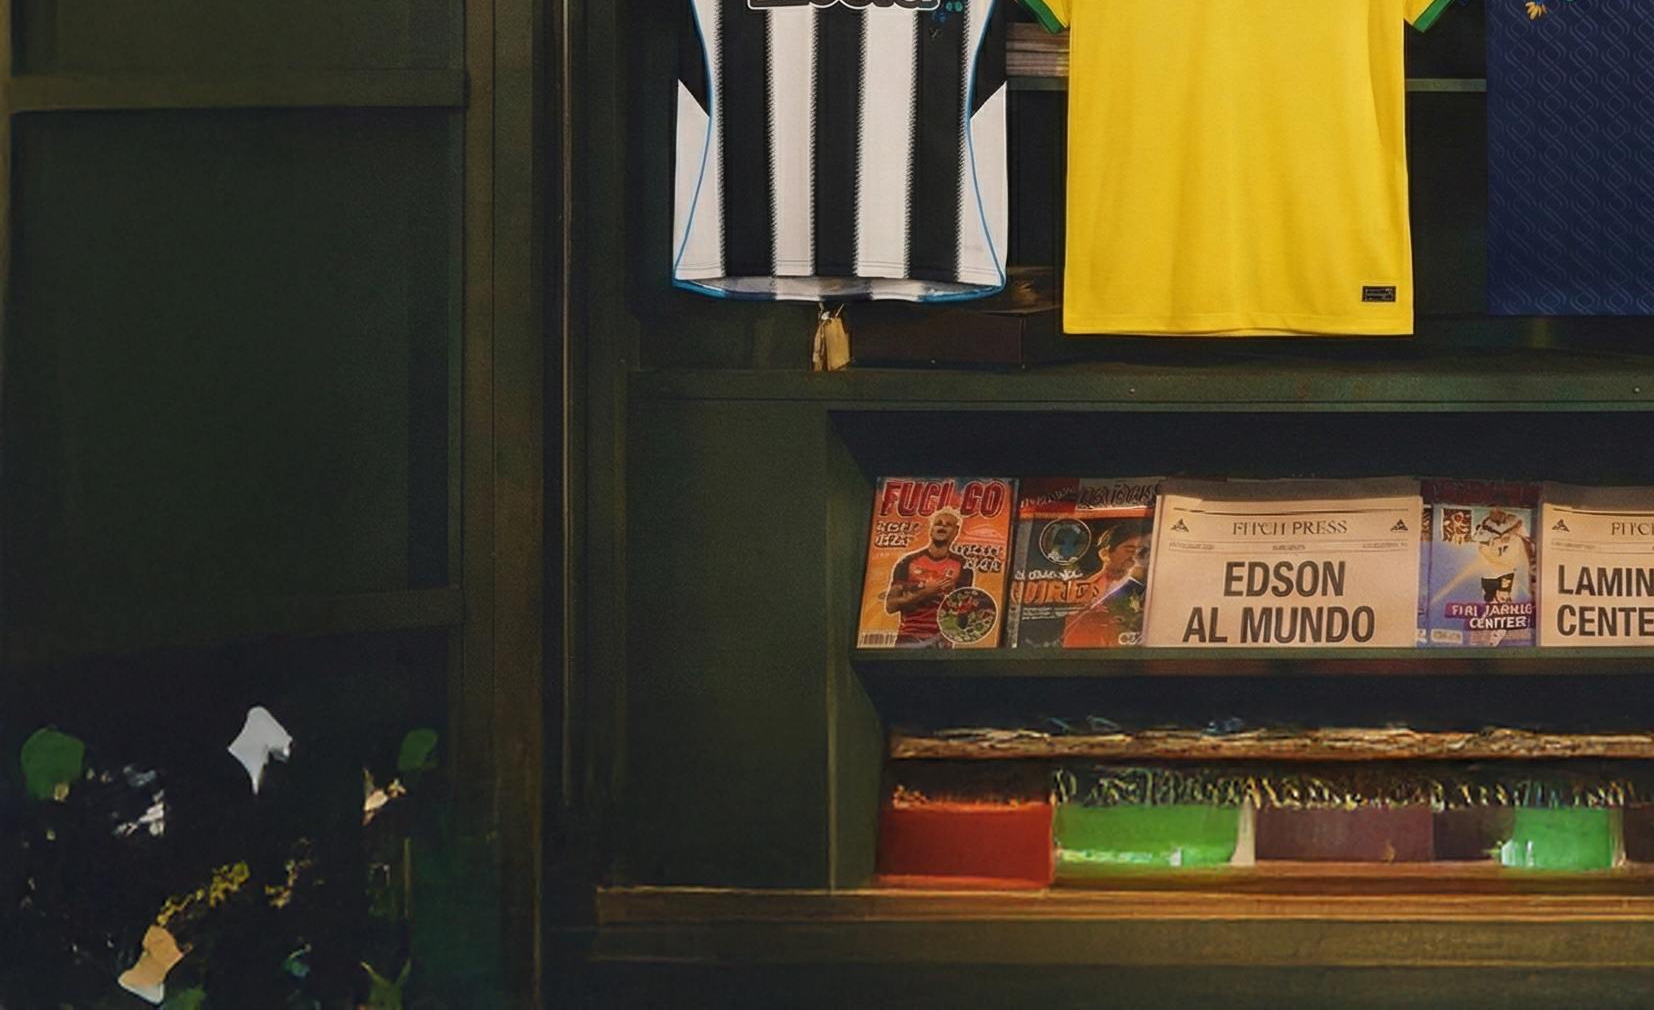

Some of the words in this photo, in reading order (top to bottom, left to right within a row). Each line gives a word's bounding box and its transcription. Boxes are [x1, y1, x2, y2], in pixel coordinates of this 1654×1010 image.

[1292, 520, 1348, 535] PRESS
[1223, 560, 1346, 598] EDSON
[1182, 606, 1229, 644] AL
[1239, 605, 1376, 644] MUNDO
